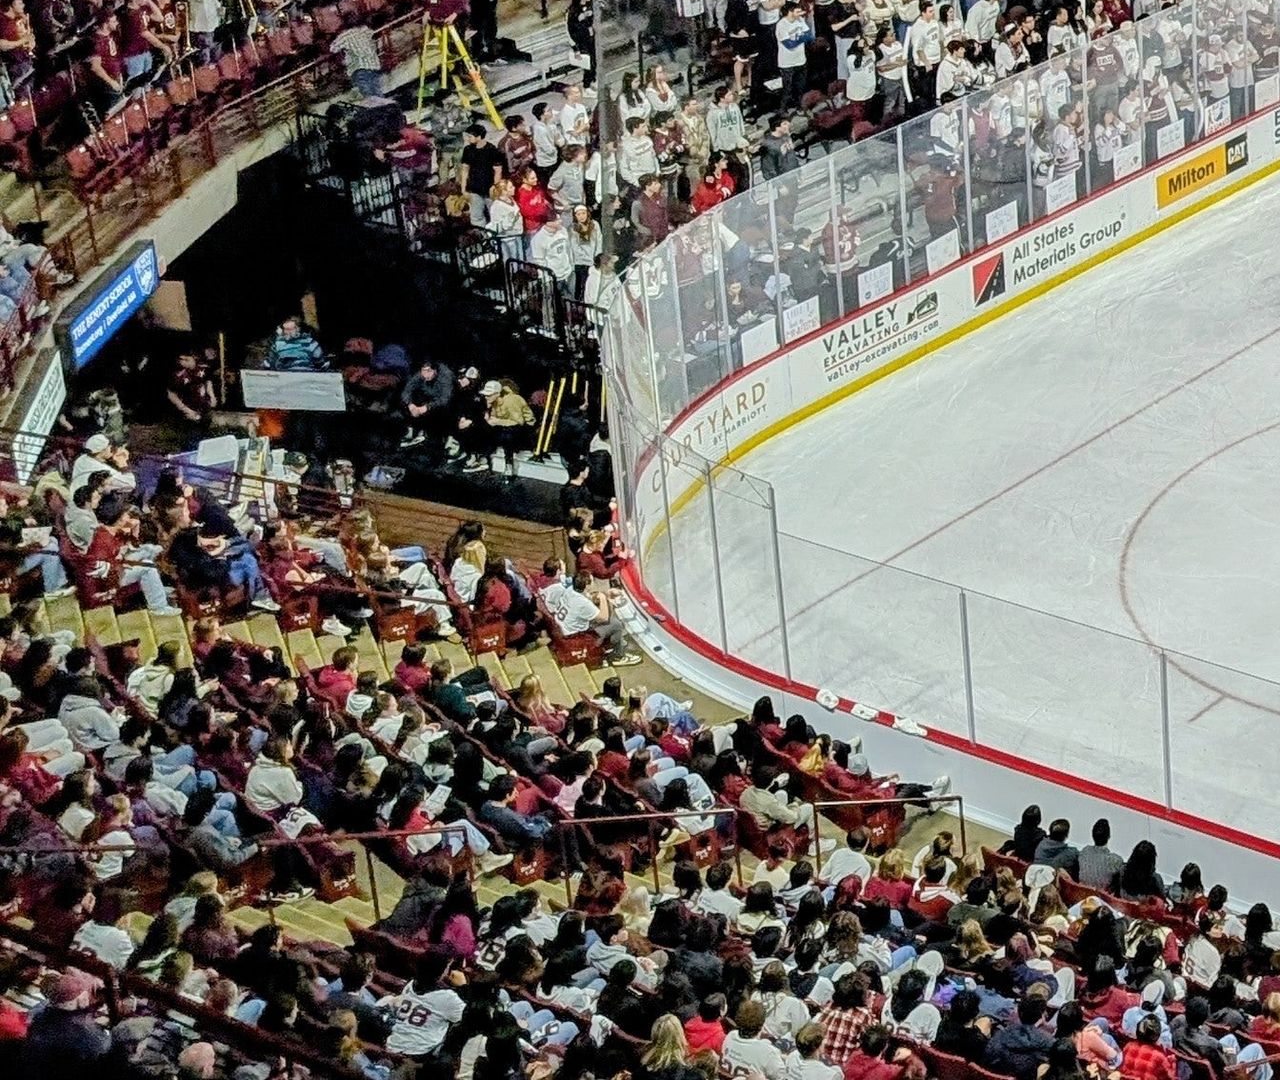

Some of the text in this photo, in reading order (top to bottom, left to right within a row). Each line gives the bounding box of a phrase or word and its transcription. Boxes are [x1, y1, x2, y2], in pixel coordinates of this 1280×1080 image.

[1227, 140, 1247, 165] CAT
[1168, 161, 1215, 196] Milton
[1012, 222, 1075, 264] All States
[1013, 241, 1077, 284] Materials
[72, 321, 87, 340] THE
[108, 274, 133, 304] SCHOOL
[822, 303, 899, 352] VALLEY
[824, 322, 900, 368] EXCAVATING
[826, 318, 940, 383] valley-excavating.com
[399, 999, 432, 1026] 28
